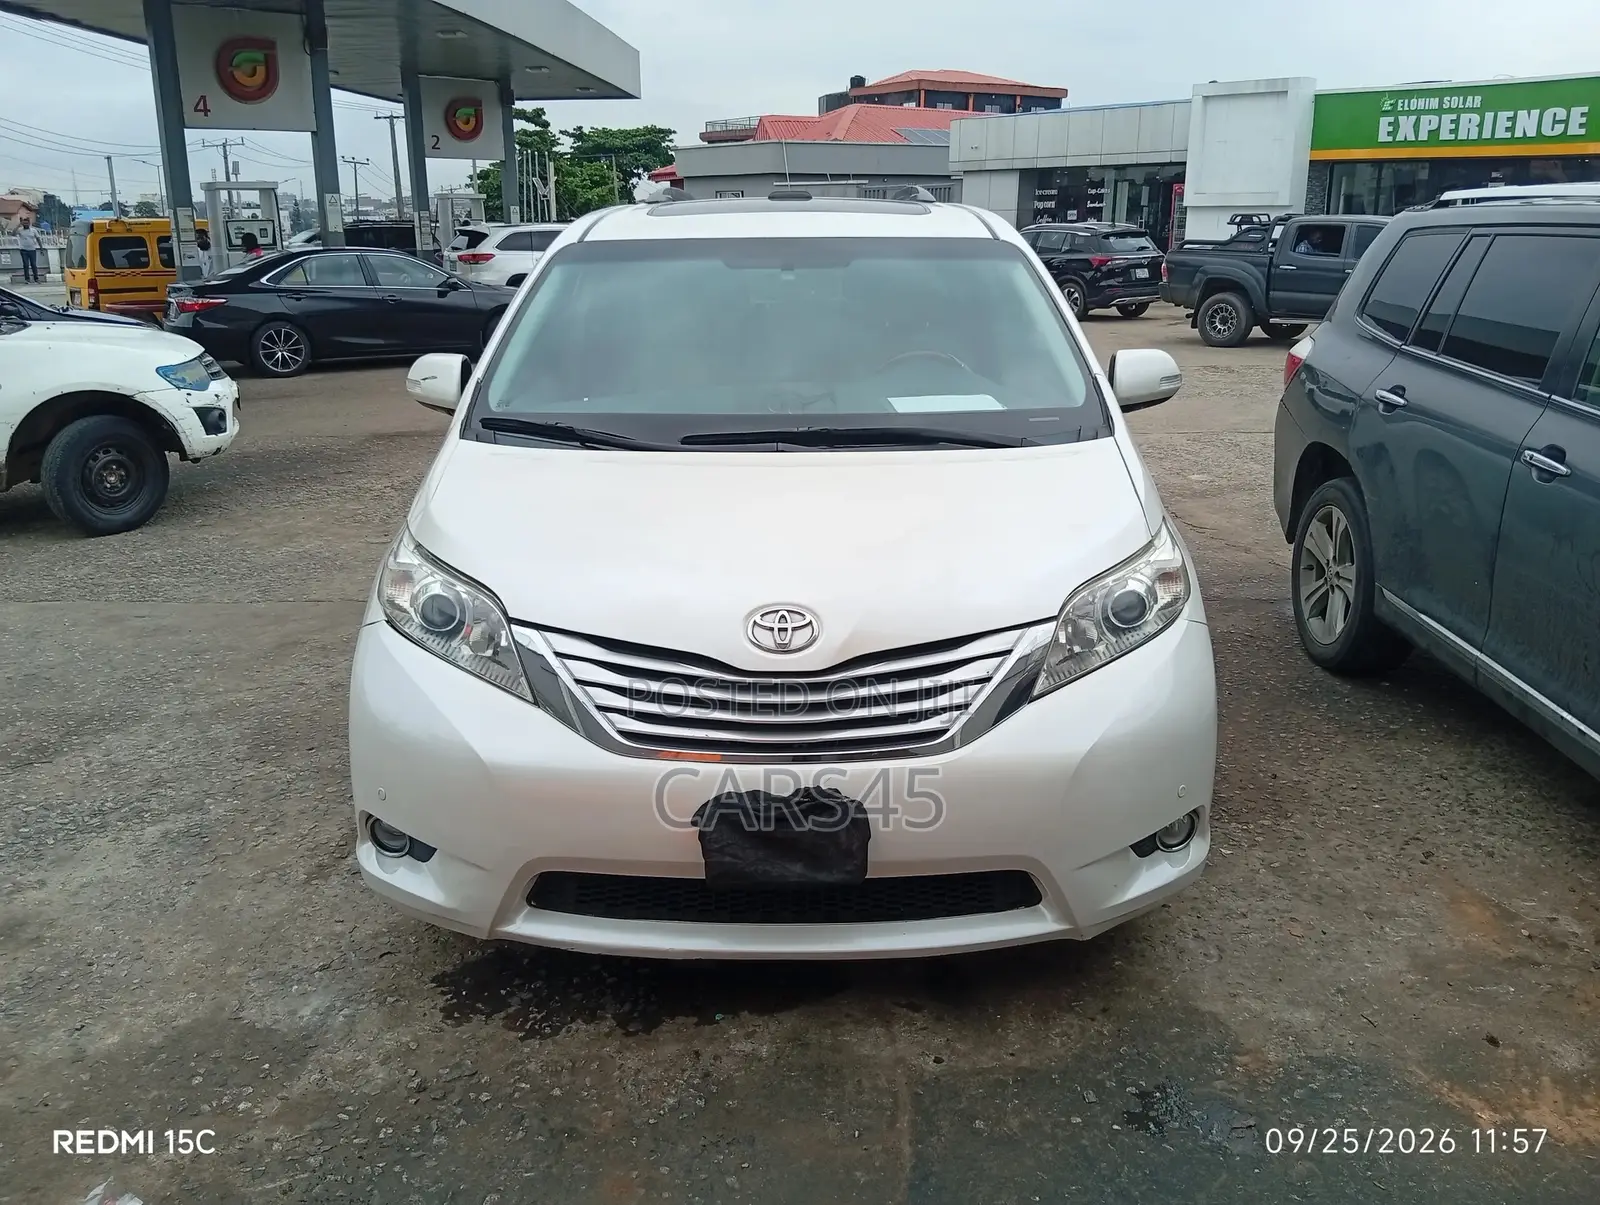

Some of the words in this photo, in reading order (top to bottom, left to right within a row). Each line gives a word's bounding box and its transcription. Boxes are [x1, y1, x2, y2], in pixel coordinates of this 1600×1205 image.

[194, 95, 211, 117] 4
[1397, 97, 1439, 111] ELOHIM
[1443, 95, 1482, 109] SOLAR
[1377, 106, 1589, 143] EXPERIENCE
[431, 134, 441, 150] 2
